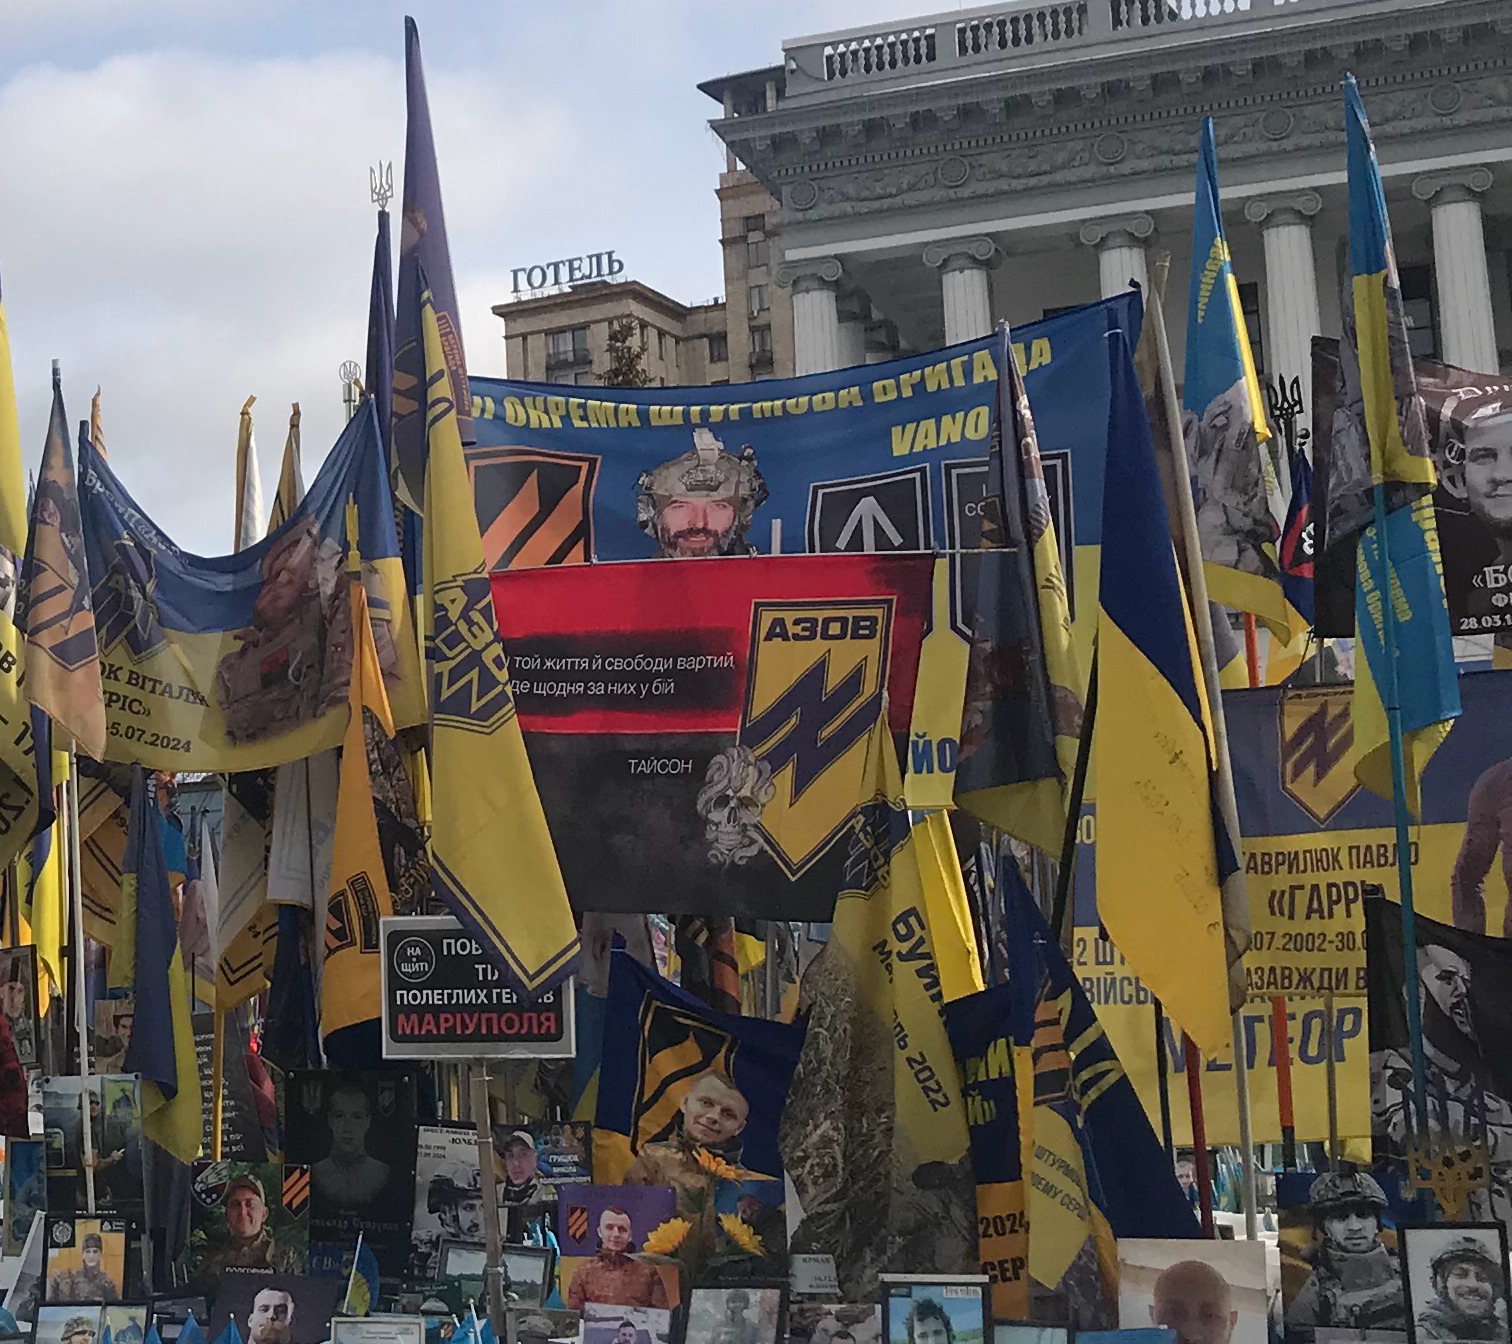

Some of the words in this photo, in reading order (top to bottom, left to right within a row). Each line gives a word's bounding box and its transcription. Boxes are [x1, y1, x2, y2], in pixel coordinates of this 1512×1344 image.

[509, 249, 625, 294] ГОТЕЛЬ
[504, 395, 641, 429] ОКРЕМА
[891, 406, 990, 457] VANO
[762, 613, 880, 643] АЗОВ
[1459, 613, 1512, 630] 28.03.1
[514, 654, 540, 670] той
[543, 656, 589, 671] життя
[592, 654, 602, 670] й
[605, 653, 673, 673] свободи
[533, 680, 584, 698] щодня
[587, 682, 605, 695] за
[608, 682, 637, 695] них
[640, 682, 650, 698] у
[652, 678, 675, 695] бій
[103, 689, 152, 718] РІС»
[628, 758, 692, 775] ТАЙСОН
[1242, 847, 1344, 875] АВРИЛЮК
[406, 946, 422, 956] НА
[442, 938, 483, 956] ПОВ
[400, 962, 429, 974] ЩИТІ
[1245, 965, 1349, 994] АЗАВЖДИ
[396, 988, 488, 1006] ПОЛЕГЛИХ
[1082, 971, 1156, 1006] ВІЙСЬ
[397, 1012, 557, 1036] МАРІУПОЛЯ
[905, 1050, 952, 1113] 2022
